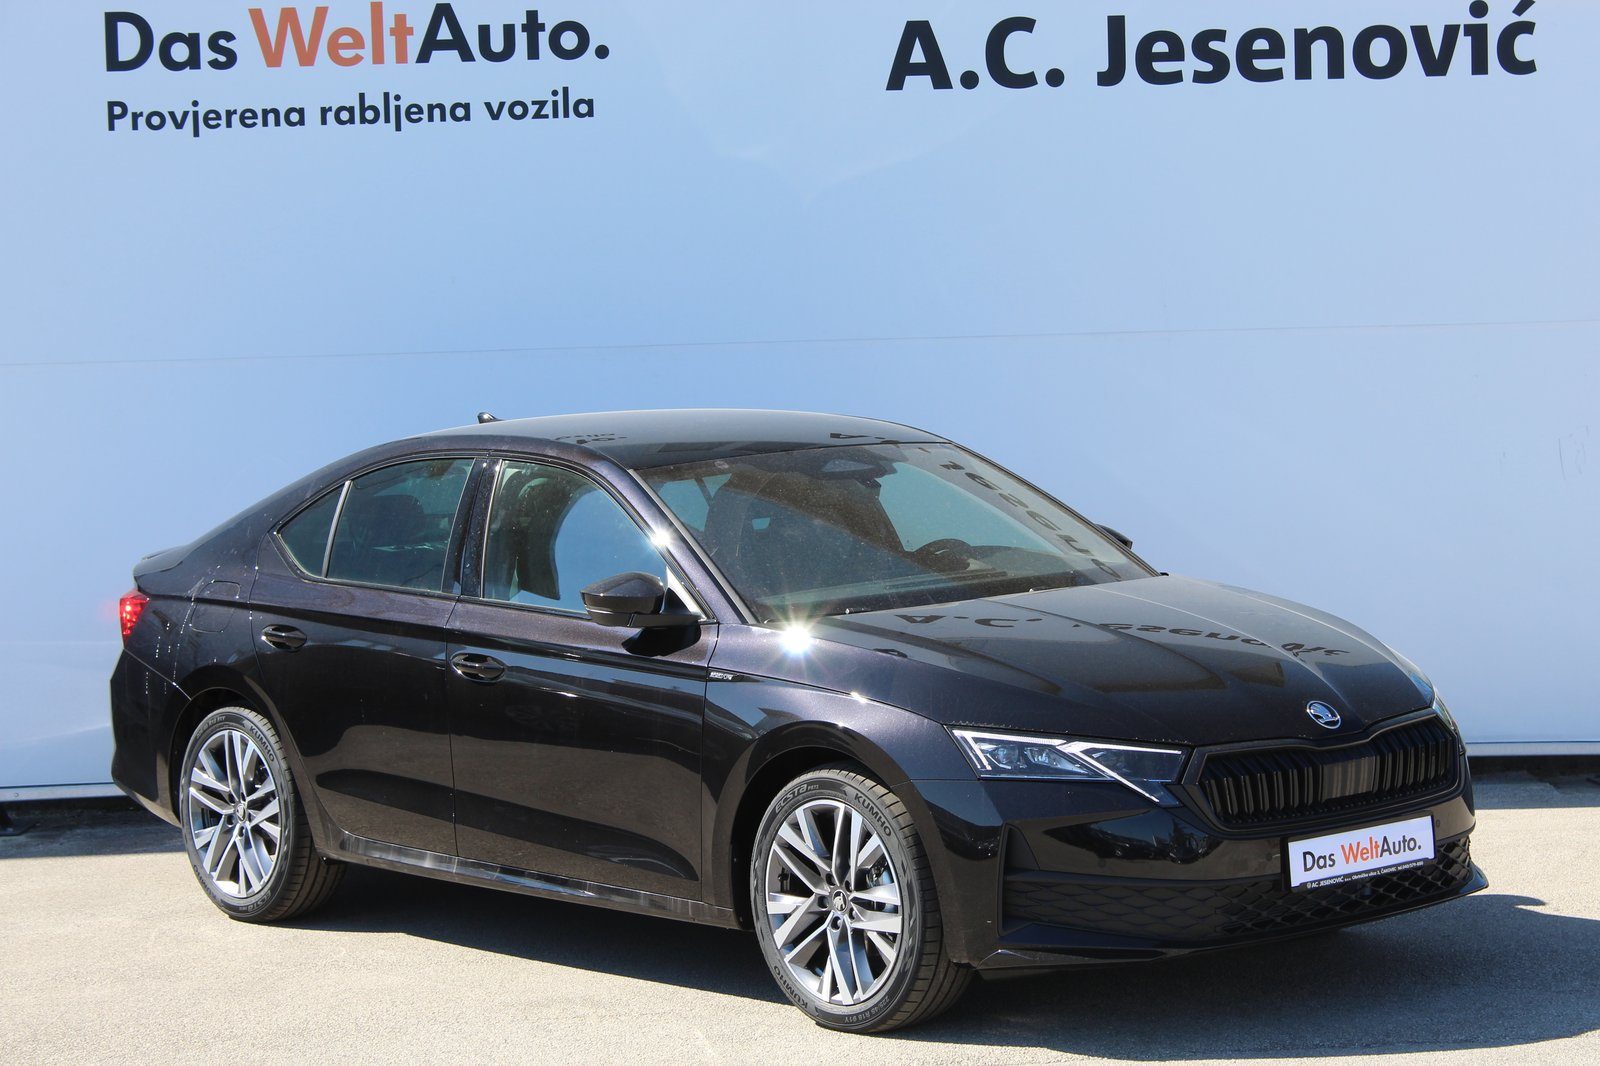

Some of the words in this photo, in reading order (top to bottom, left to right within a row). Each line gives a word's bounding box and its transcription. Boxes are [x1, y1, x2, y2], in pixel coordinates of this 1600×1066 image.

[105, 12, 237, 72] Das
[248, 2, 609, 67] WeltAuto.
[886, 17, 1064, 90] A.C.
[1097, 0, 1537, 86] Jesenović
[107, 100, 305, 137] Provjerena
[320, 92, 470, 131] rabljena
[484, 87, 594, 120] vozila
[249, 725, 275, 762] KUMHO
[853, 791, 893, 838] KUMHO
[1302, 850, 1336, 872] Das
[1340, 834, 1422, 865] WeltAuto.
[1319, 875, 1345, 887] JESENOVIĆ
[773, 964, 809, 1010] KUMHO
